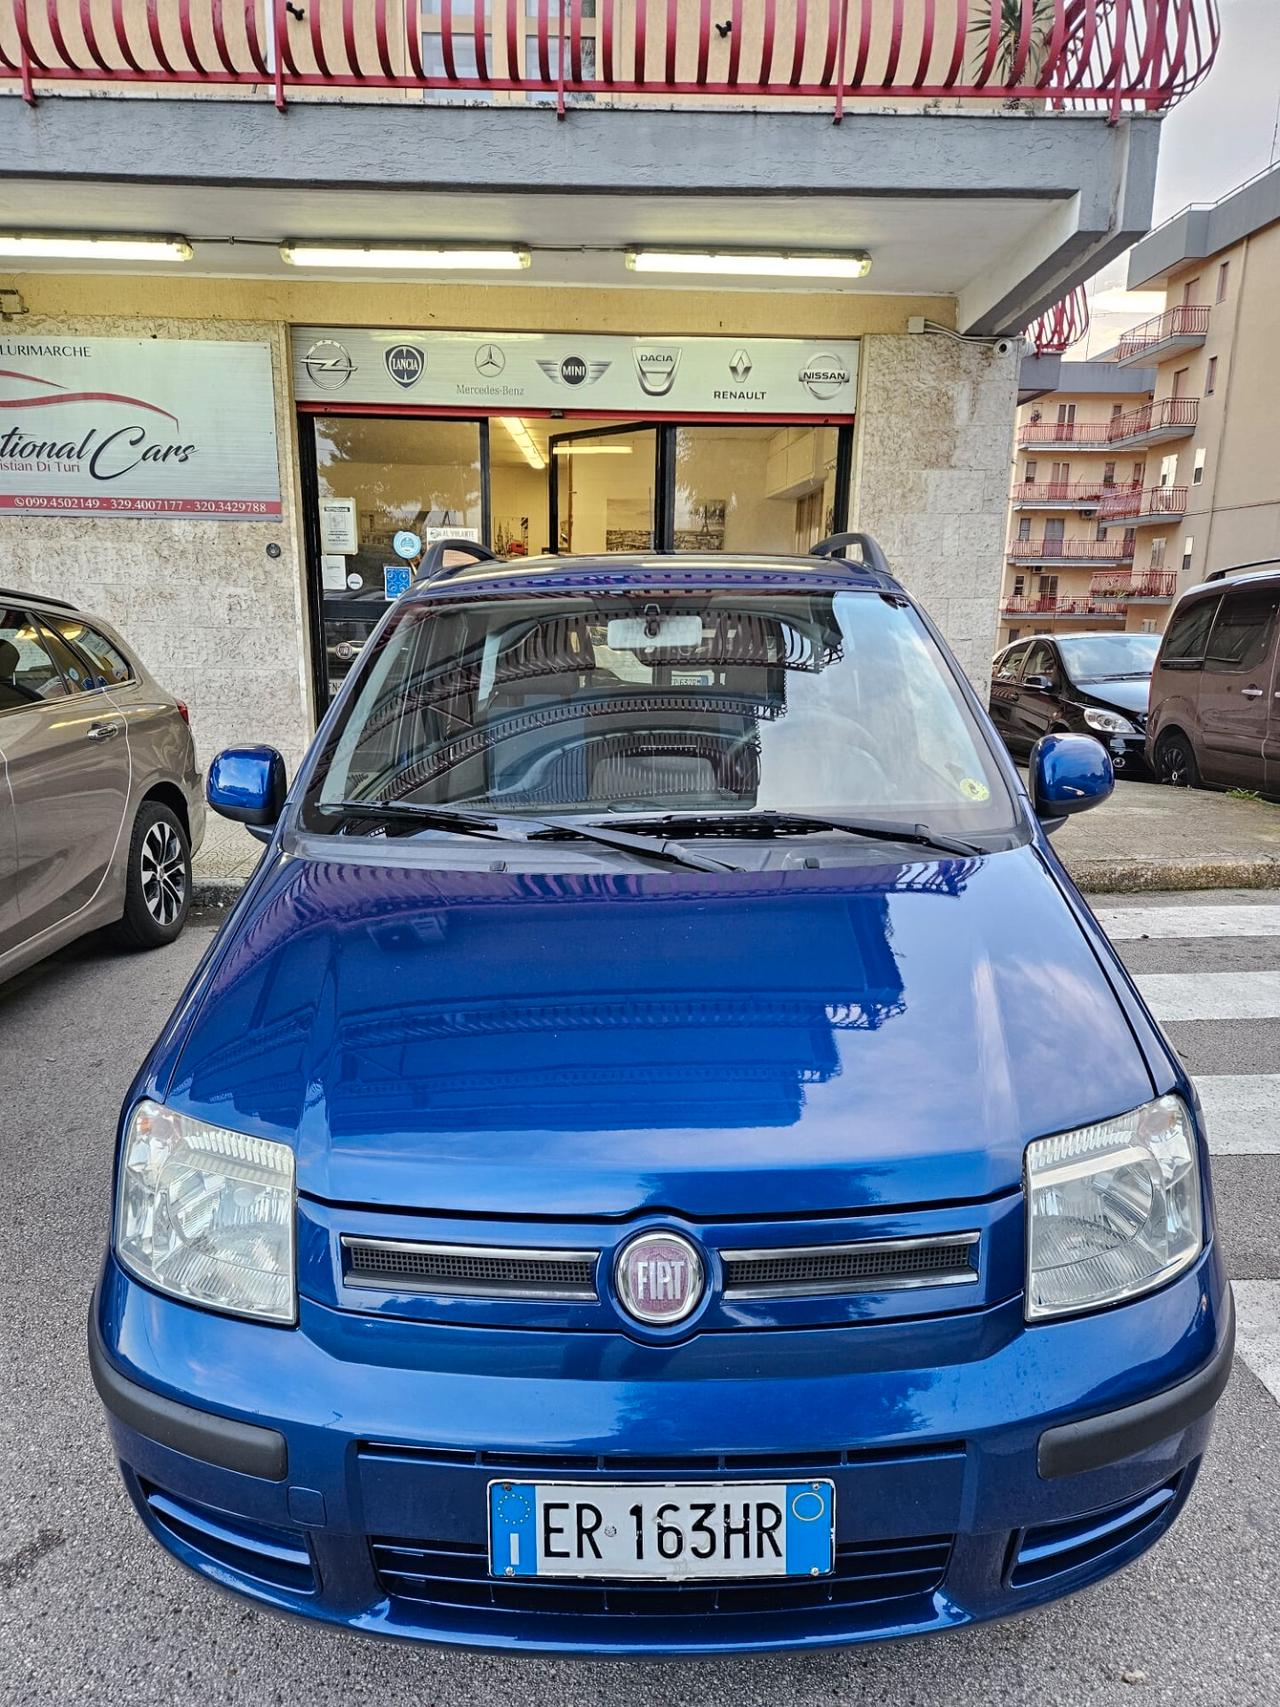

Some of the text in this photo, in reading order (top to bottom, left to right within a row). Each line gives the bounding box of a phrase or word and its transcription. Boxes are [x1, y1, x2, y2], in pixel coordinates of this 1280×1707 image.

[392, 358, 418, 371] LANCIA
[640, 354, 673, 363] DACIA
[562, 365, 586, 376] MINI
[803, 371, 846, 380] NISSAN
[456, 384, 525, 396] Mercedes-Benz
[713, 390, 767, 400] RENAULT
[89, 426, 199, 480] Cars
[36, 461, 51, 472] Di
[54, 461, 80, 473] Turi
[25, 497, 100, 509] 099.4502149
[111, 499, 183, 511] 329.4007177
[194, 501, 267, 513] 320.3429788
[637, 1261, 685, 1300] FIAT
[543, 1503, 783, 1560] ER 163HR
